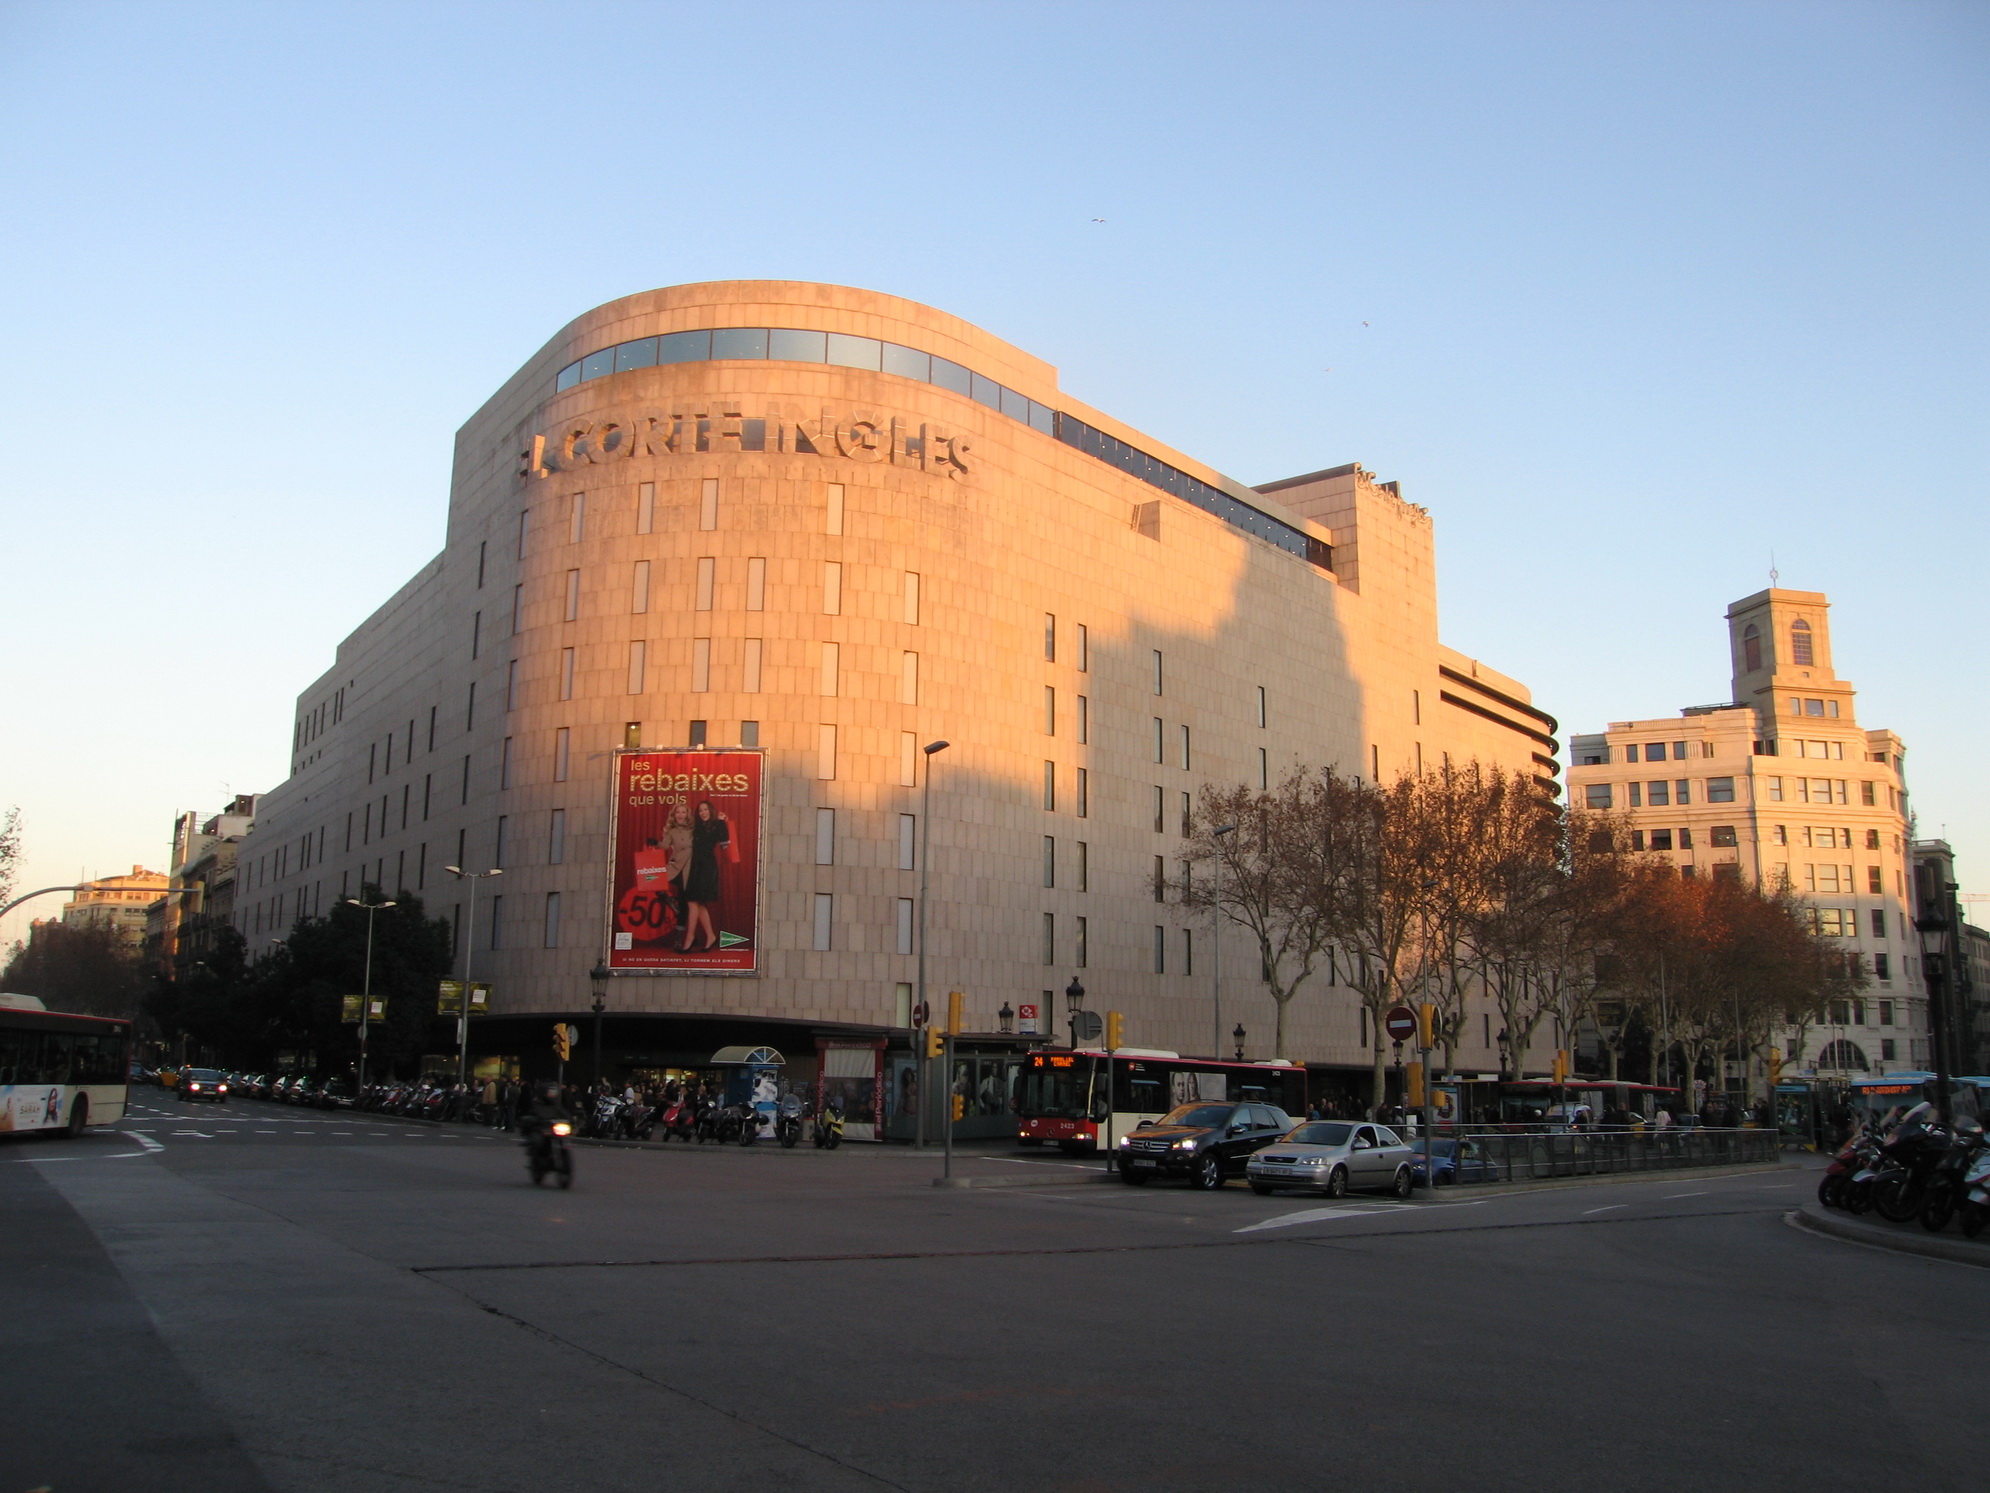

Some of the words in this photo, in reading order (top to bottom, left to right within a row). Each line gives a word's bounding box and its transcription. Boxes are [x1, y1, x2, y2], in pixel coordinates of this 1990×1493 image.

[556, 401, 742, 472] CORTE
[631, 760, 650, 771] les
[630, 768, 749, 792] rebaixes
[629, 795, 655, 807] que
[658, 793, 687, 805] vols
[636, 866, 667, 875] rebaixes
[1034, 1056, 1044, 1067] 24
